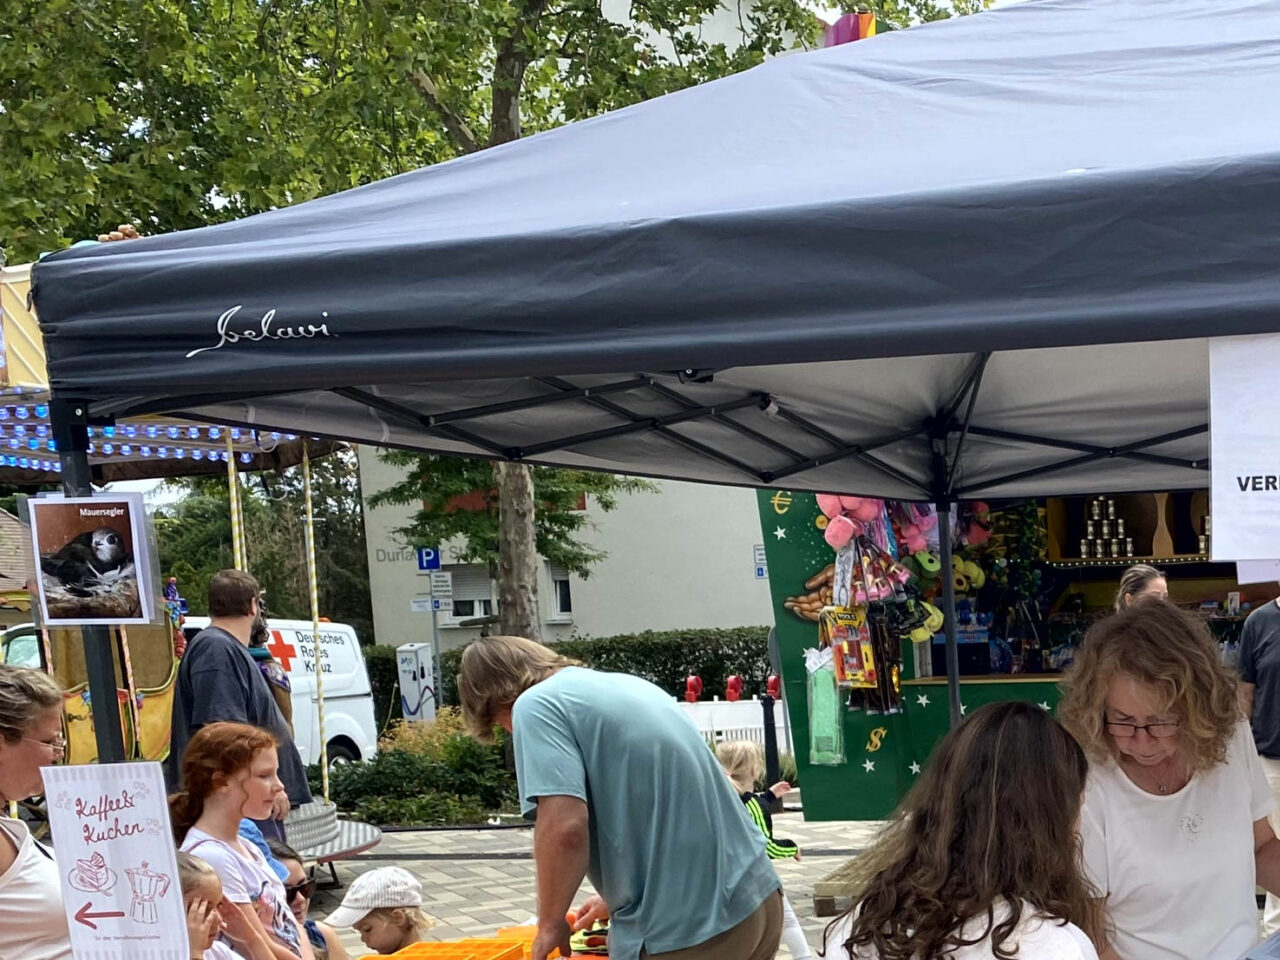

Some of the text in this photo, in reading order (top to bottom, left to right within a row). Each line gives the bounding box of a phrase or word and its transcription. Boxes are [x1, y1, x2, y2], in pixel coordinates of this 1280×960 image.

[80, 507, 124, 517] Mauersegler
[422, 548, 434, 568] P
[295, 631, 344, 645] Deusches
[300, 645, 328, 658] Roes
[304, 660, 332, 672] Kruz
[83, 817, 144, 846] Kuchen
